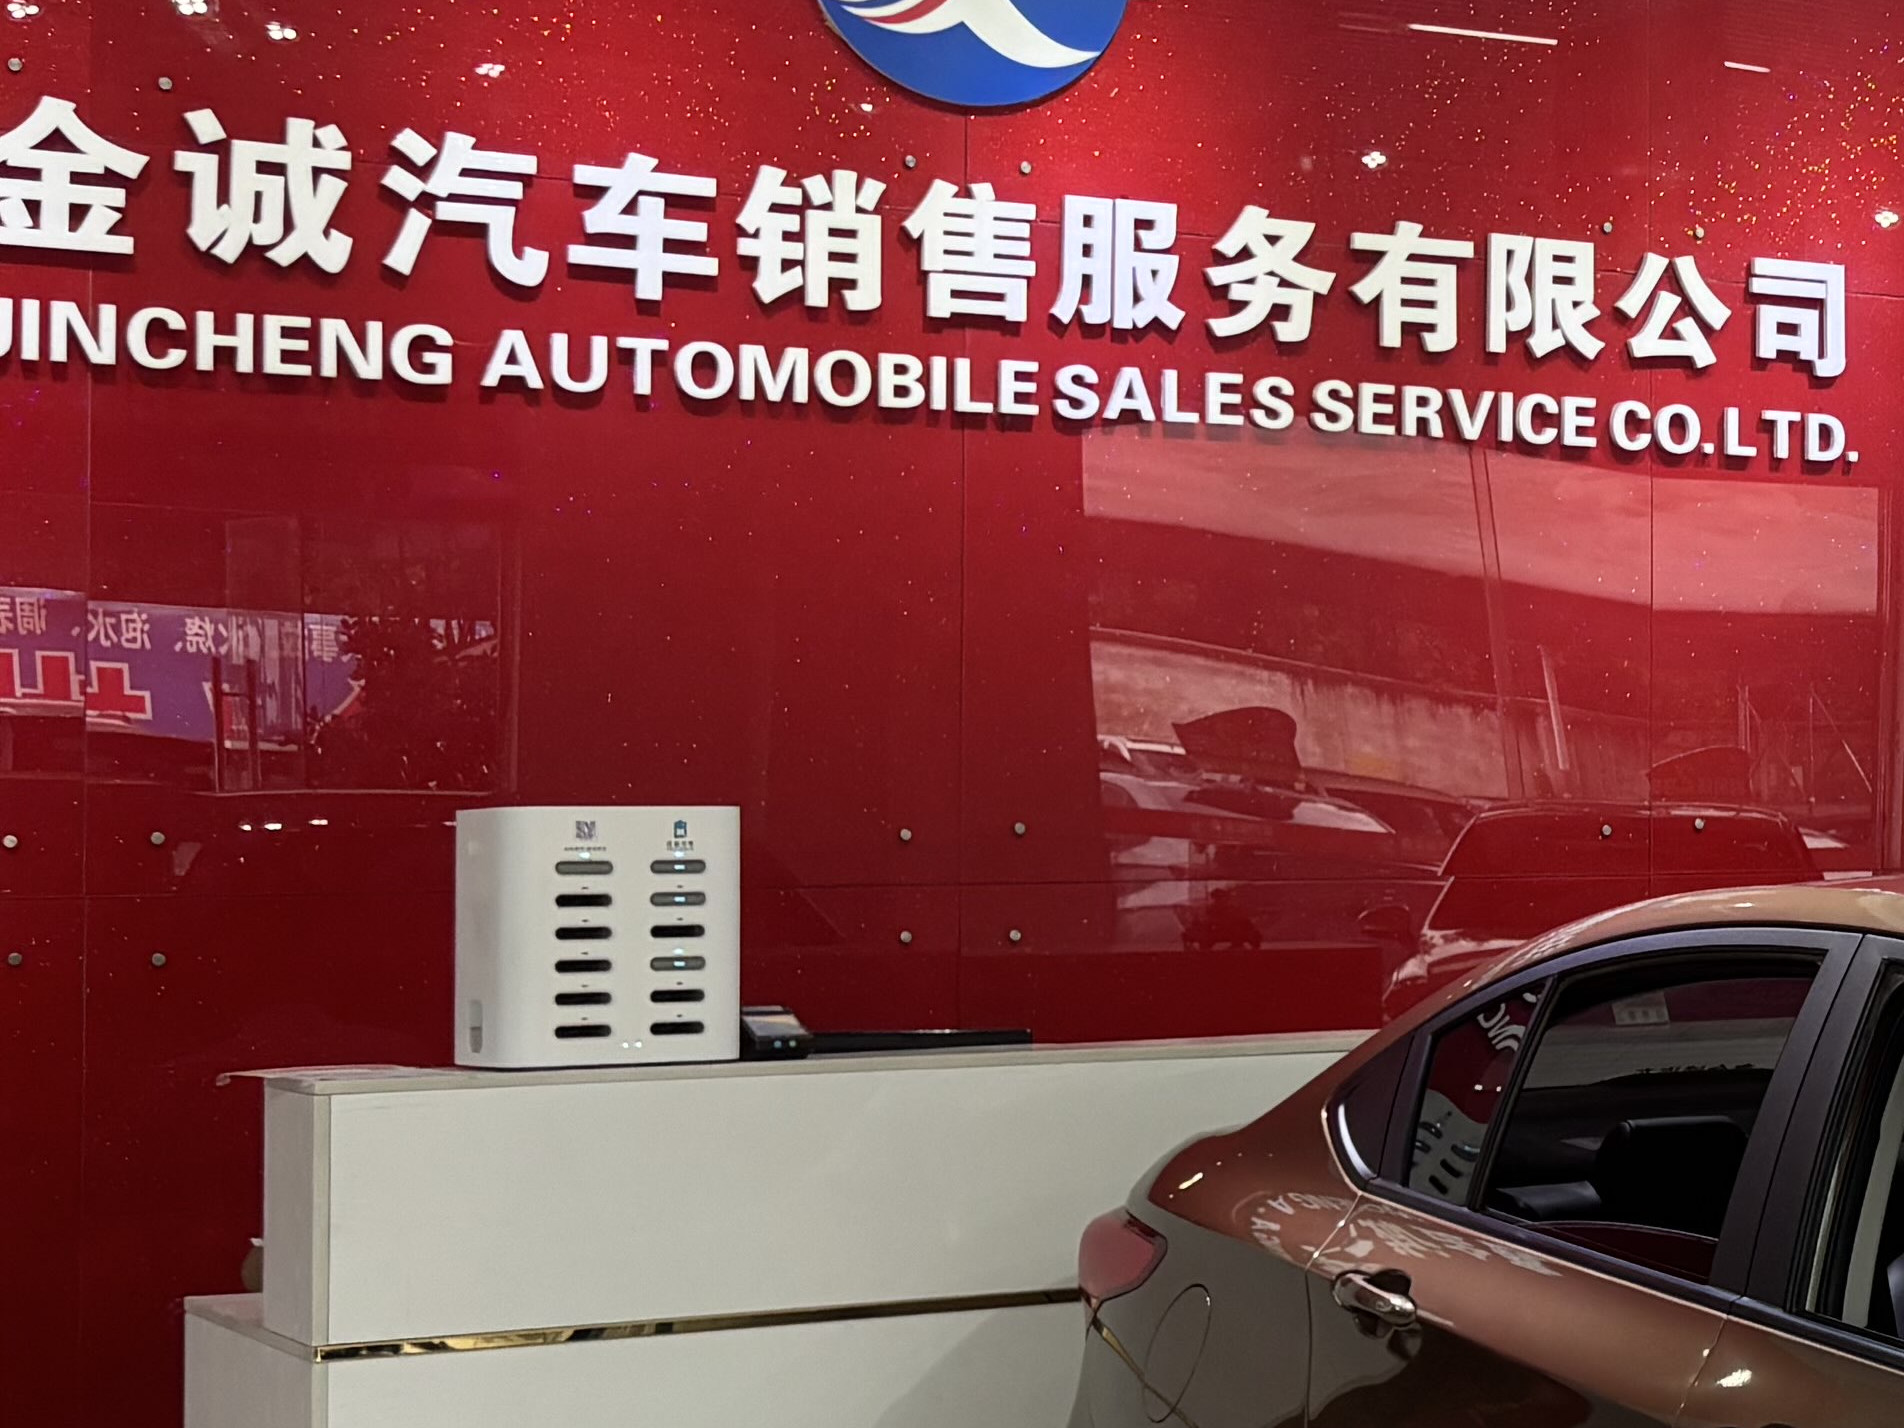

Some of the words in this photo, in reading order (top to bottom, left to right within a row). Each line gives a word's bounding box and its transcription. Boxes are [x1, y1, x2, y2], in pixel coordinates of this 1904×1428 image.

[0, 94, 1848, 379] 金诚汽车销售服务有限公司
[479, 328, 1040, 417] AUTOMOBILE
[1051, 365, 1295, 433] SALES
[1310, 381, 1598, 450] SERVICE
